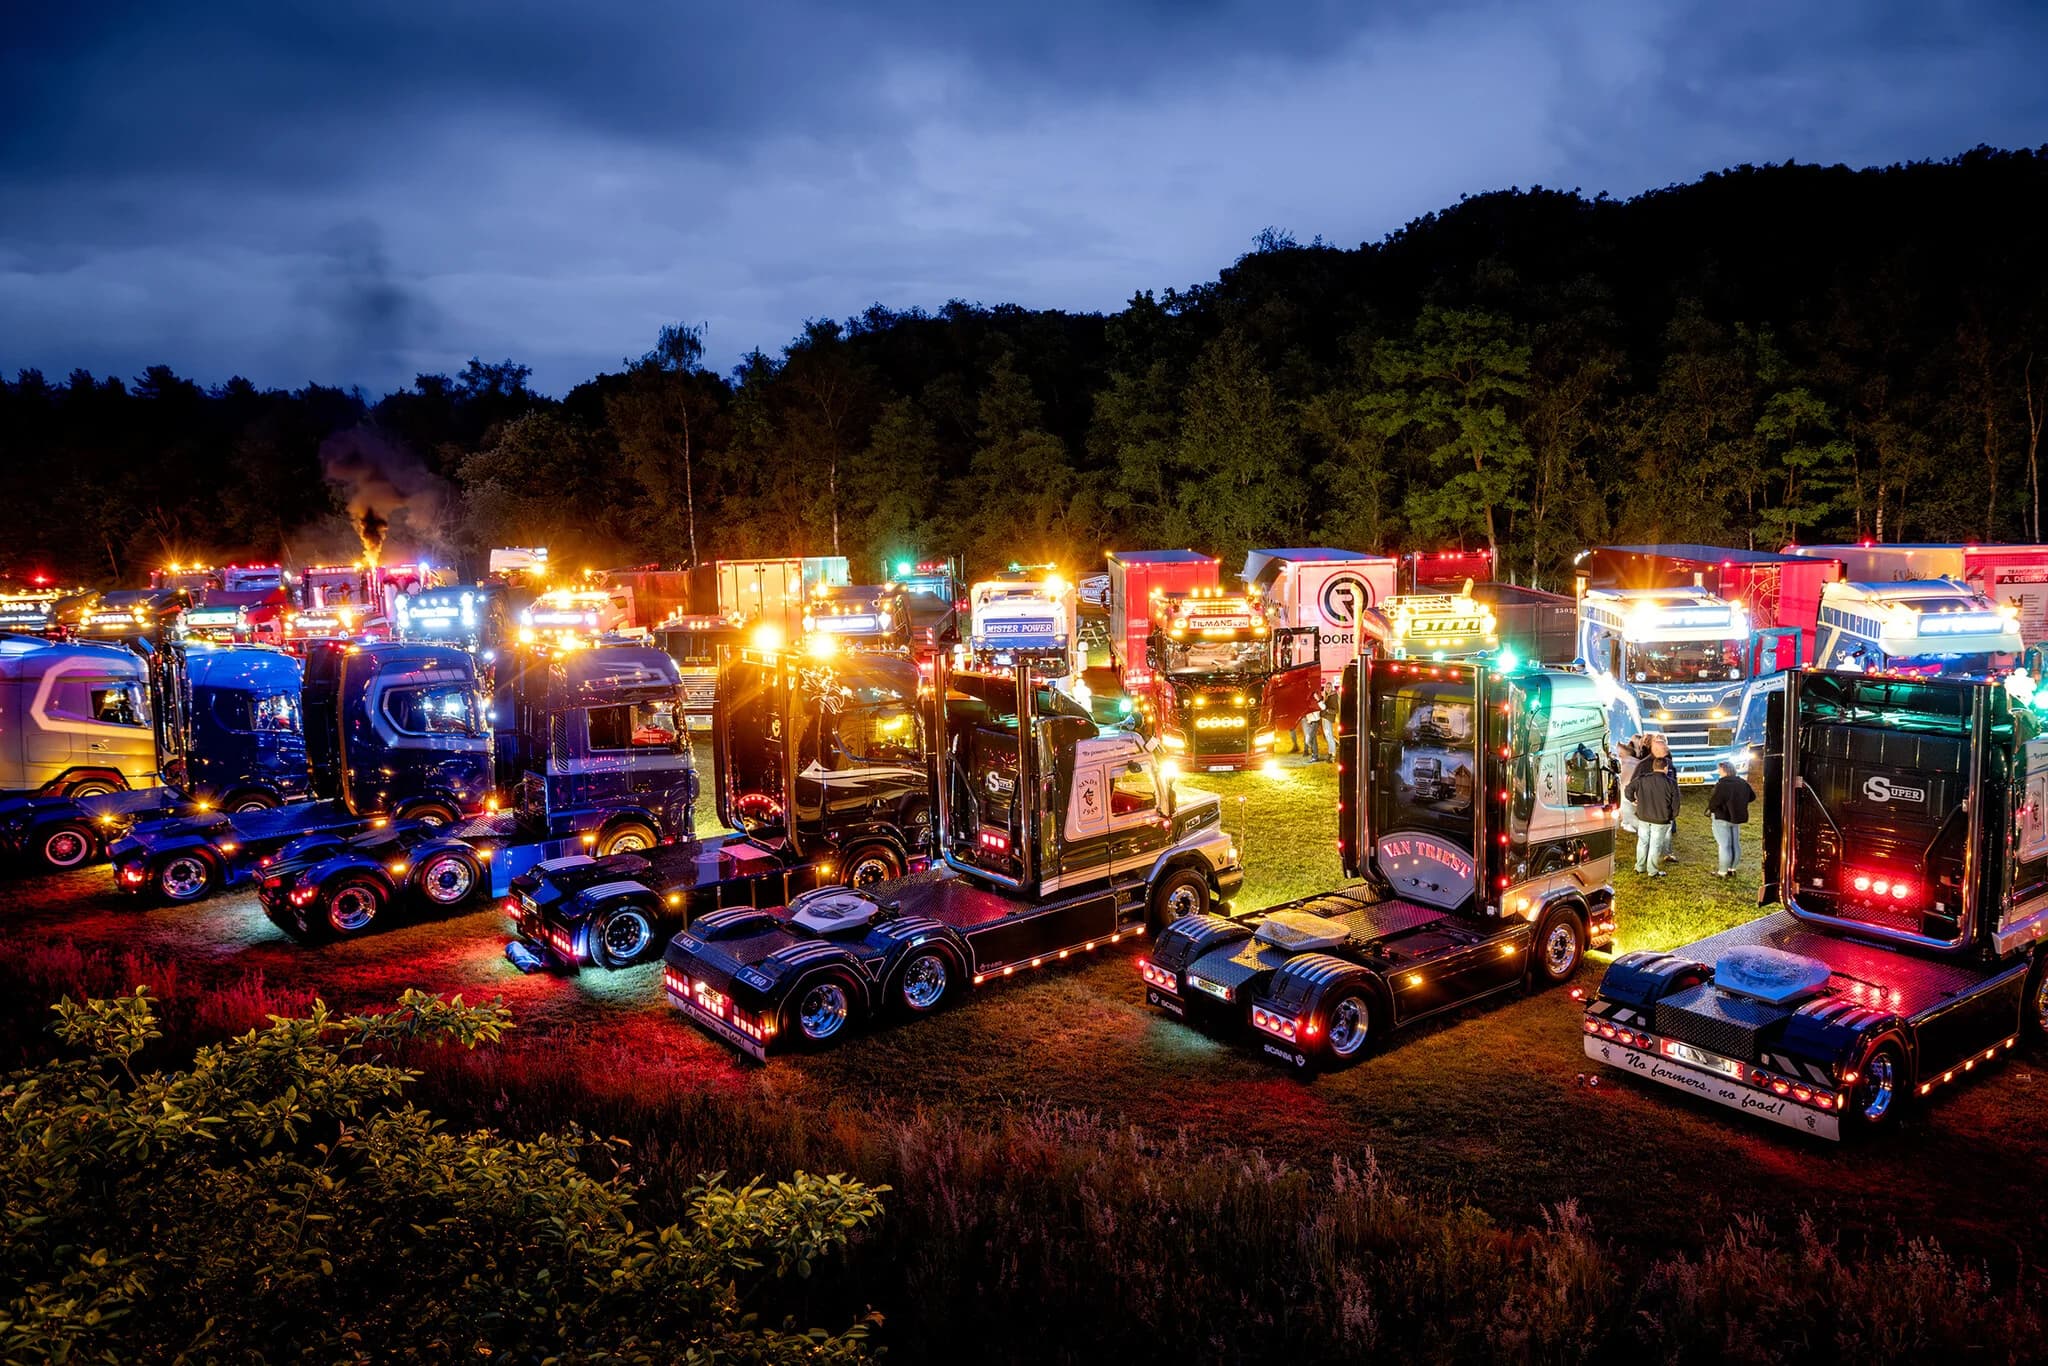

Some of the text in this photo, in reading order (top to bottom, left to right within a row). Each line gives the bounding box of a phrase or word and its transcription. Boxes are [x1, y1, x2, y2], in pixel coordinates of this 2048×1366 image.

[986, 623, 1052, 633] MISTER POWER
[1319, 634, 1354, 645] OOR
[1668, 694, 1714, 704] SCANIA
[1868, 776, 1920, 802] SUPER
[1383, 840, 1471, 879] VAN TRIEST
[1161, 1000, 1184, 1016] SCANIA
[1263, 1044, 1294, 1063] SCANIA
[1625, 1053, 1657, 1070] No
[1719, 1089, 1737, 1100] no
[1741, 1094, 1785, 1116] food!
